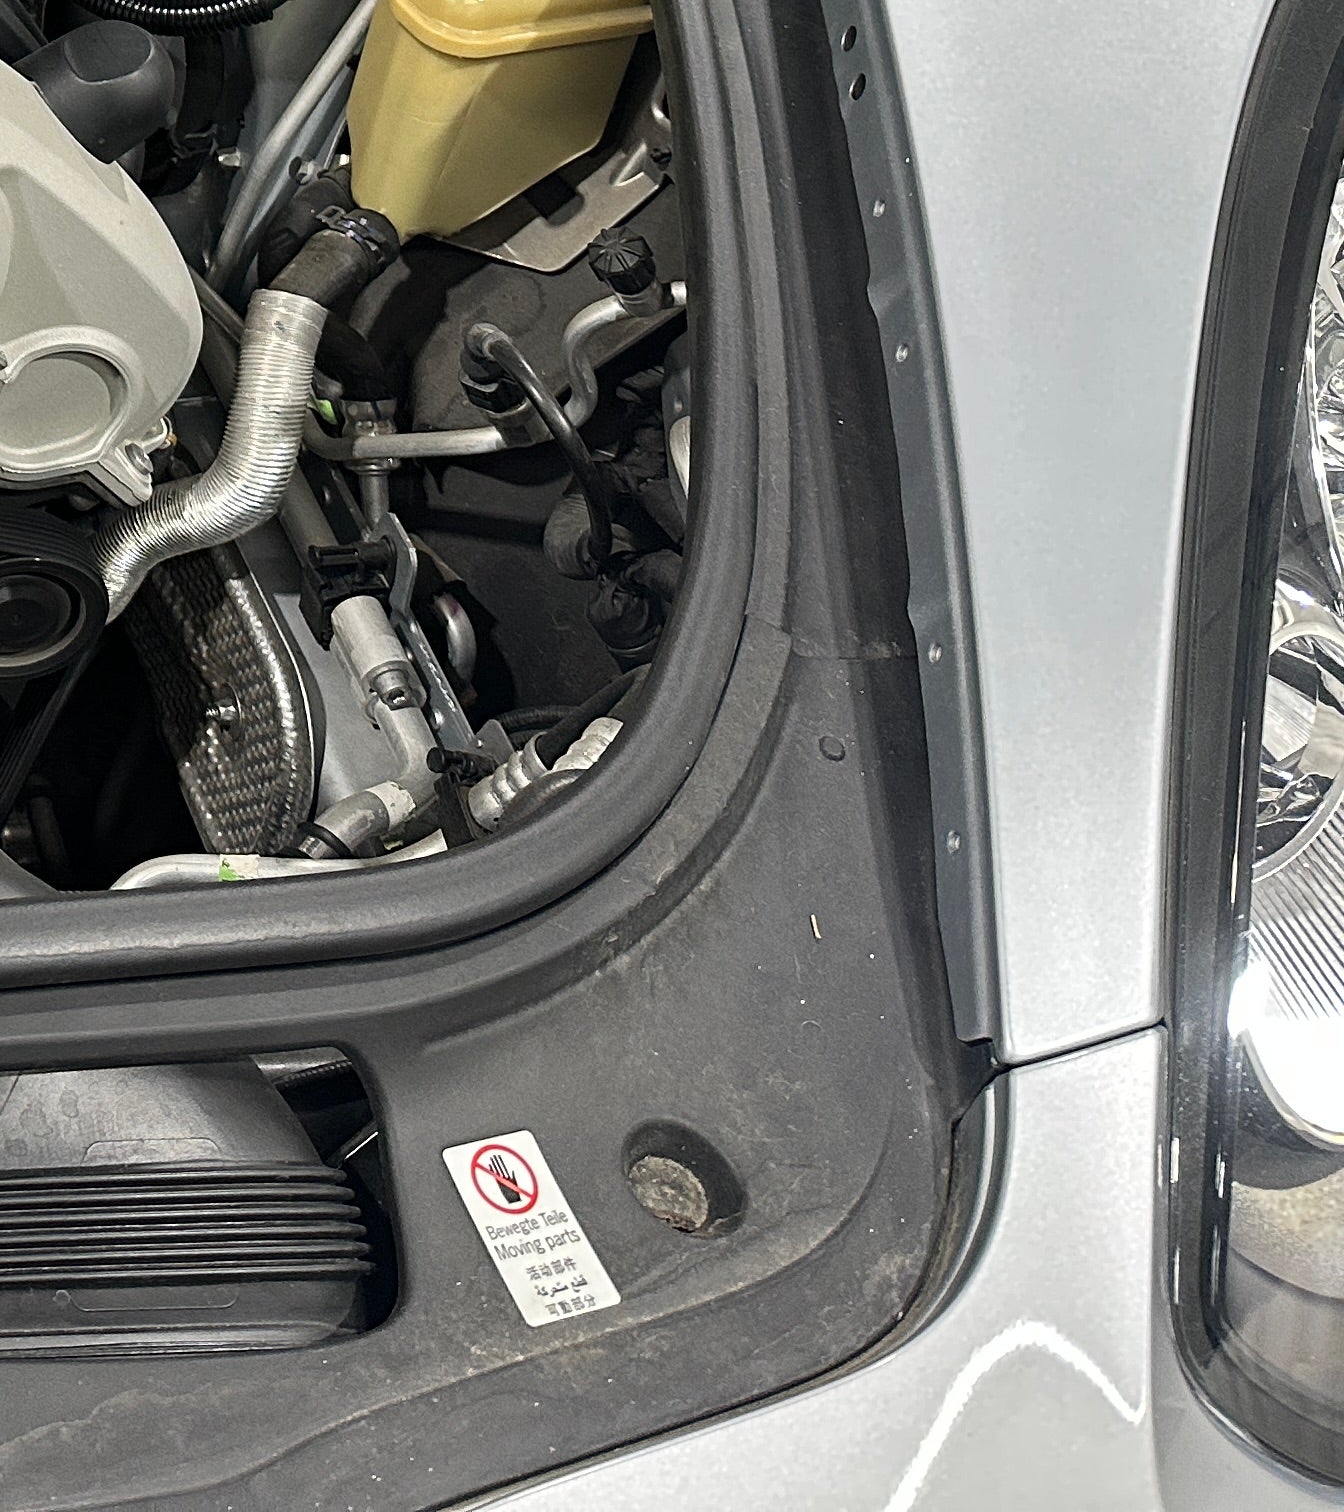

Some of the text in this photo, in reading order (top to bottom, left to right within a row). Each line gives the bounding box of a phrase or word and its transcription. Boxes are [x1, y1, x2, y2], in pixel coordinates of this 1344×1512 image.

[485, 1209, 569, 1241] Bewegte Teile
[493, 1229, 581, 1261] Moving parts
